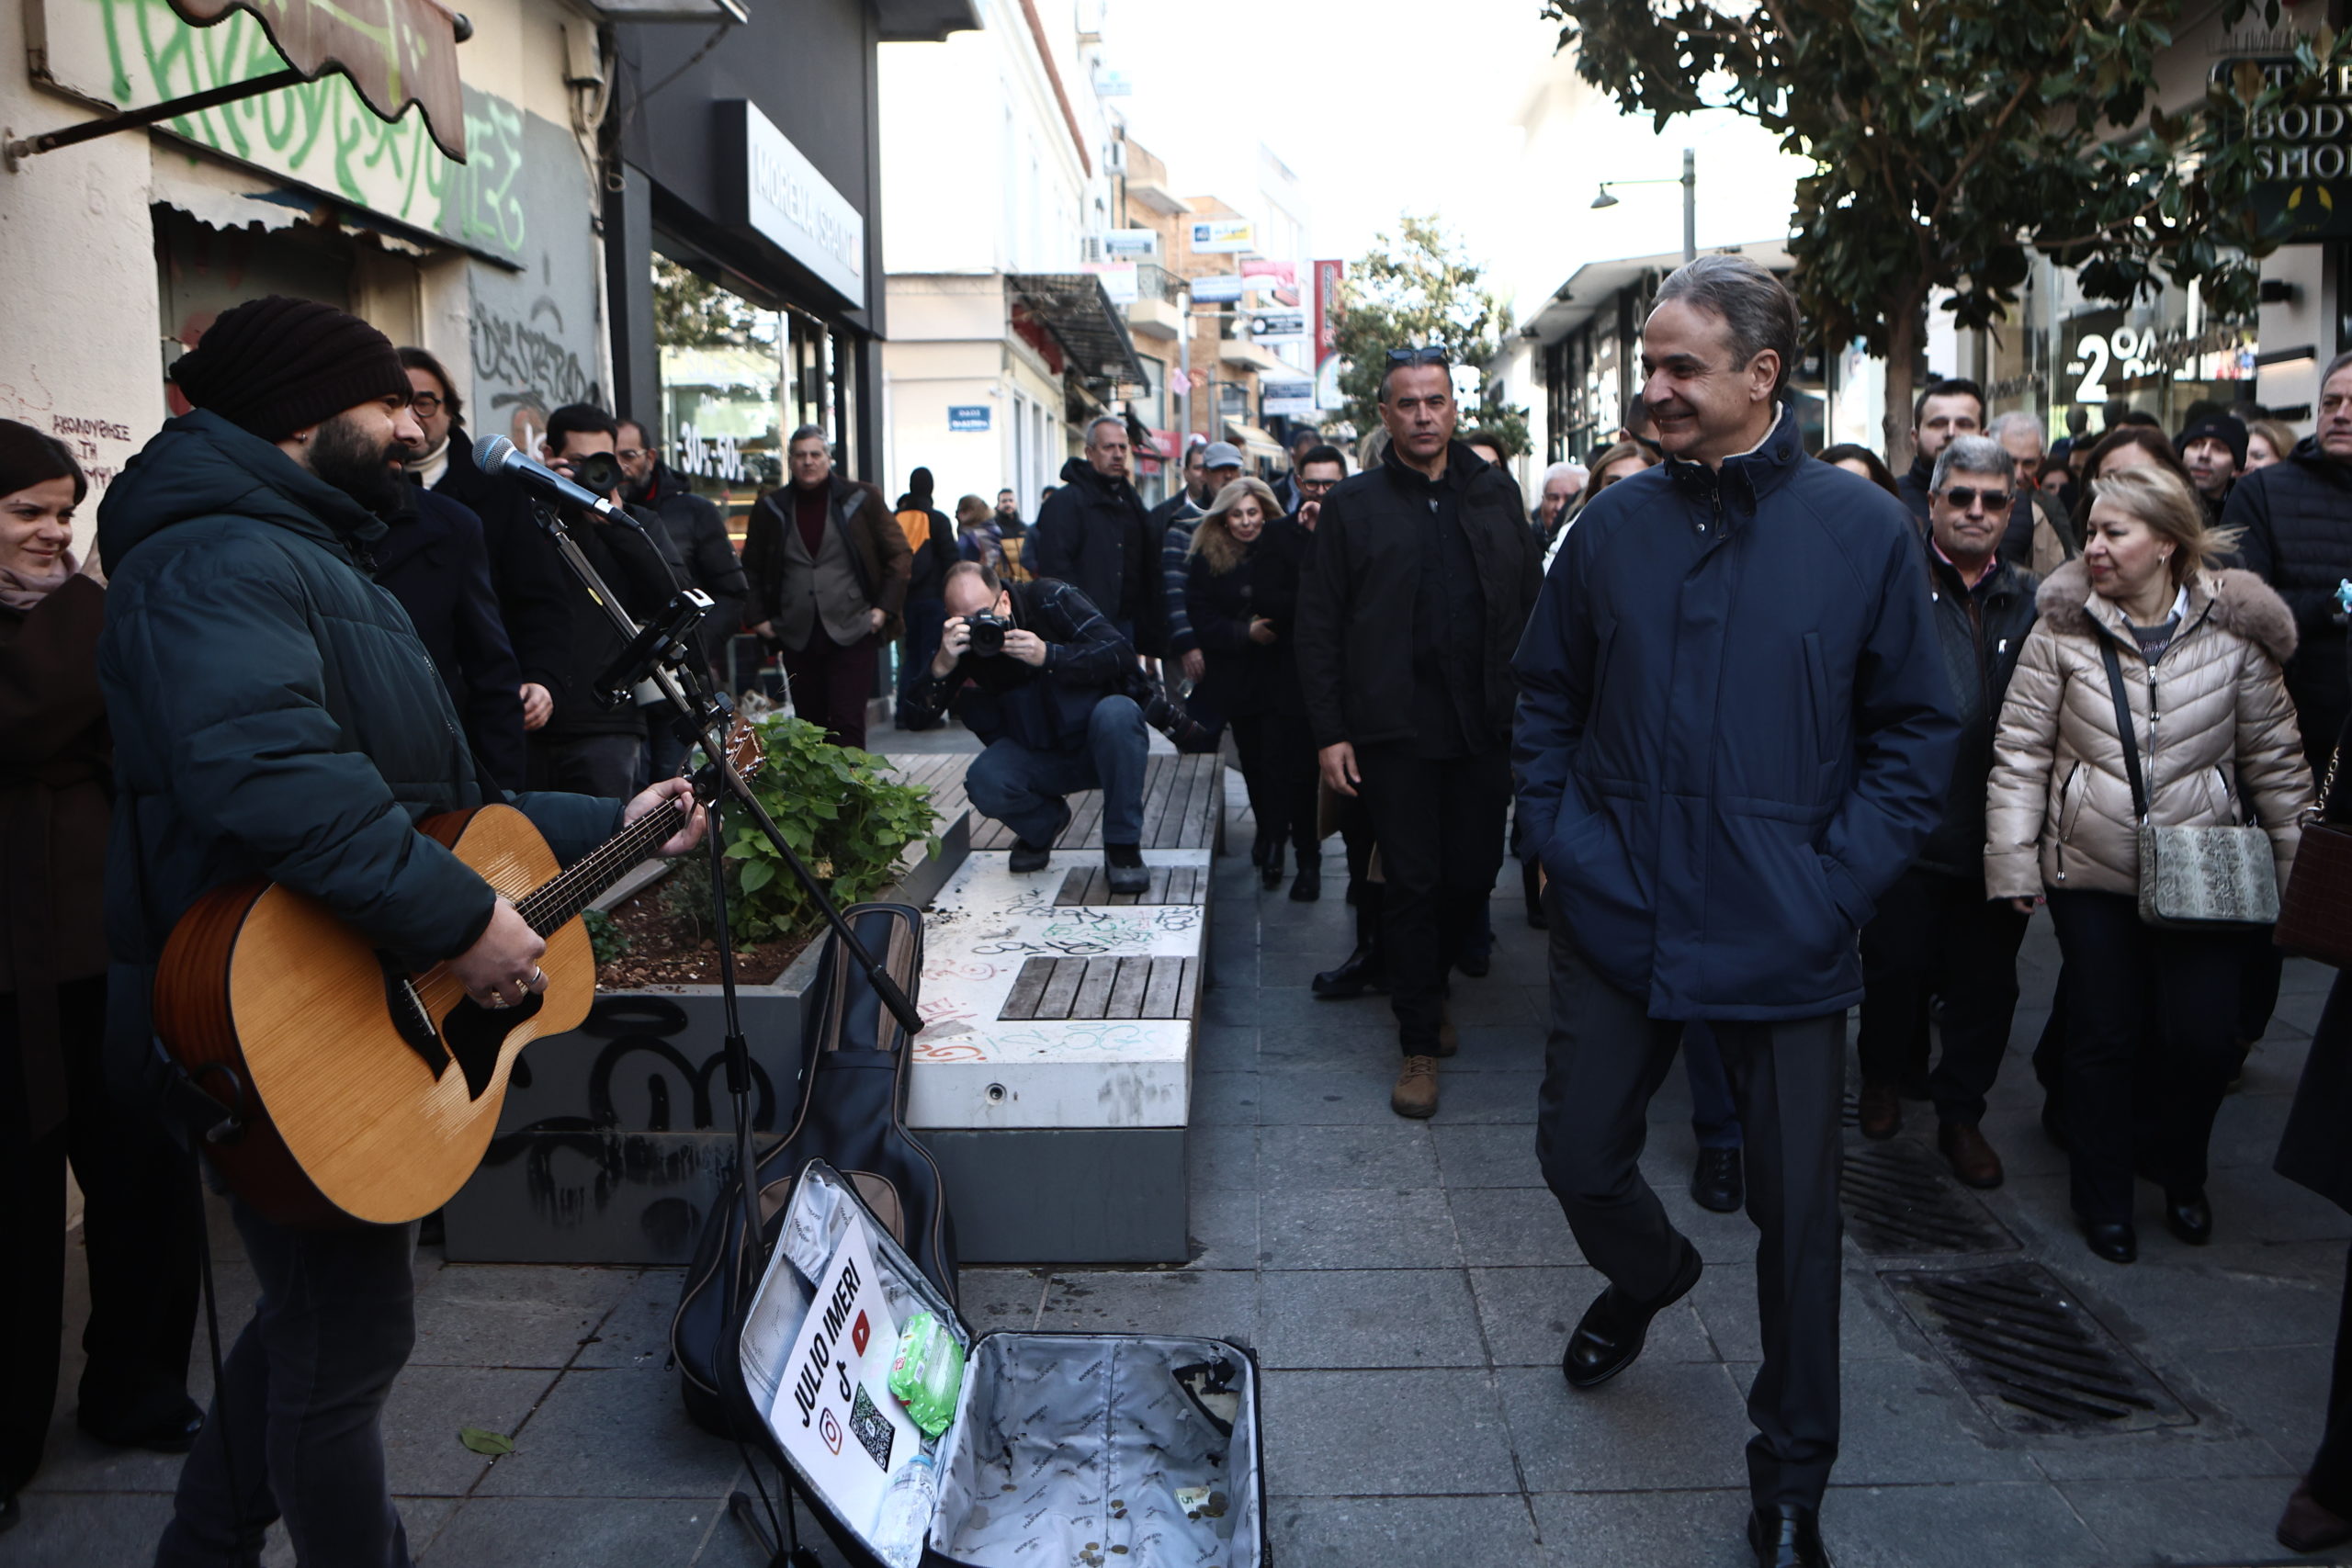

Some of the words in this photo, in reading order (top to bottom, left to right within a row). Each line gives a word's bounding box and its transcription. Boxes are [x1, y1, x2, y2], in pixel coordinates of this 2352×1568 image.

[2252, 102, 2352, 140] BOD
[2253, 143, 2352, 179] SHO
[795, 1332, 831, 1427] JULIO
[822, 1257, 861, 1346] IMERI
